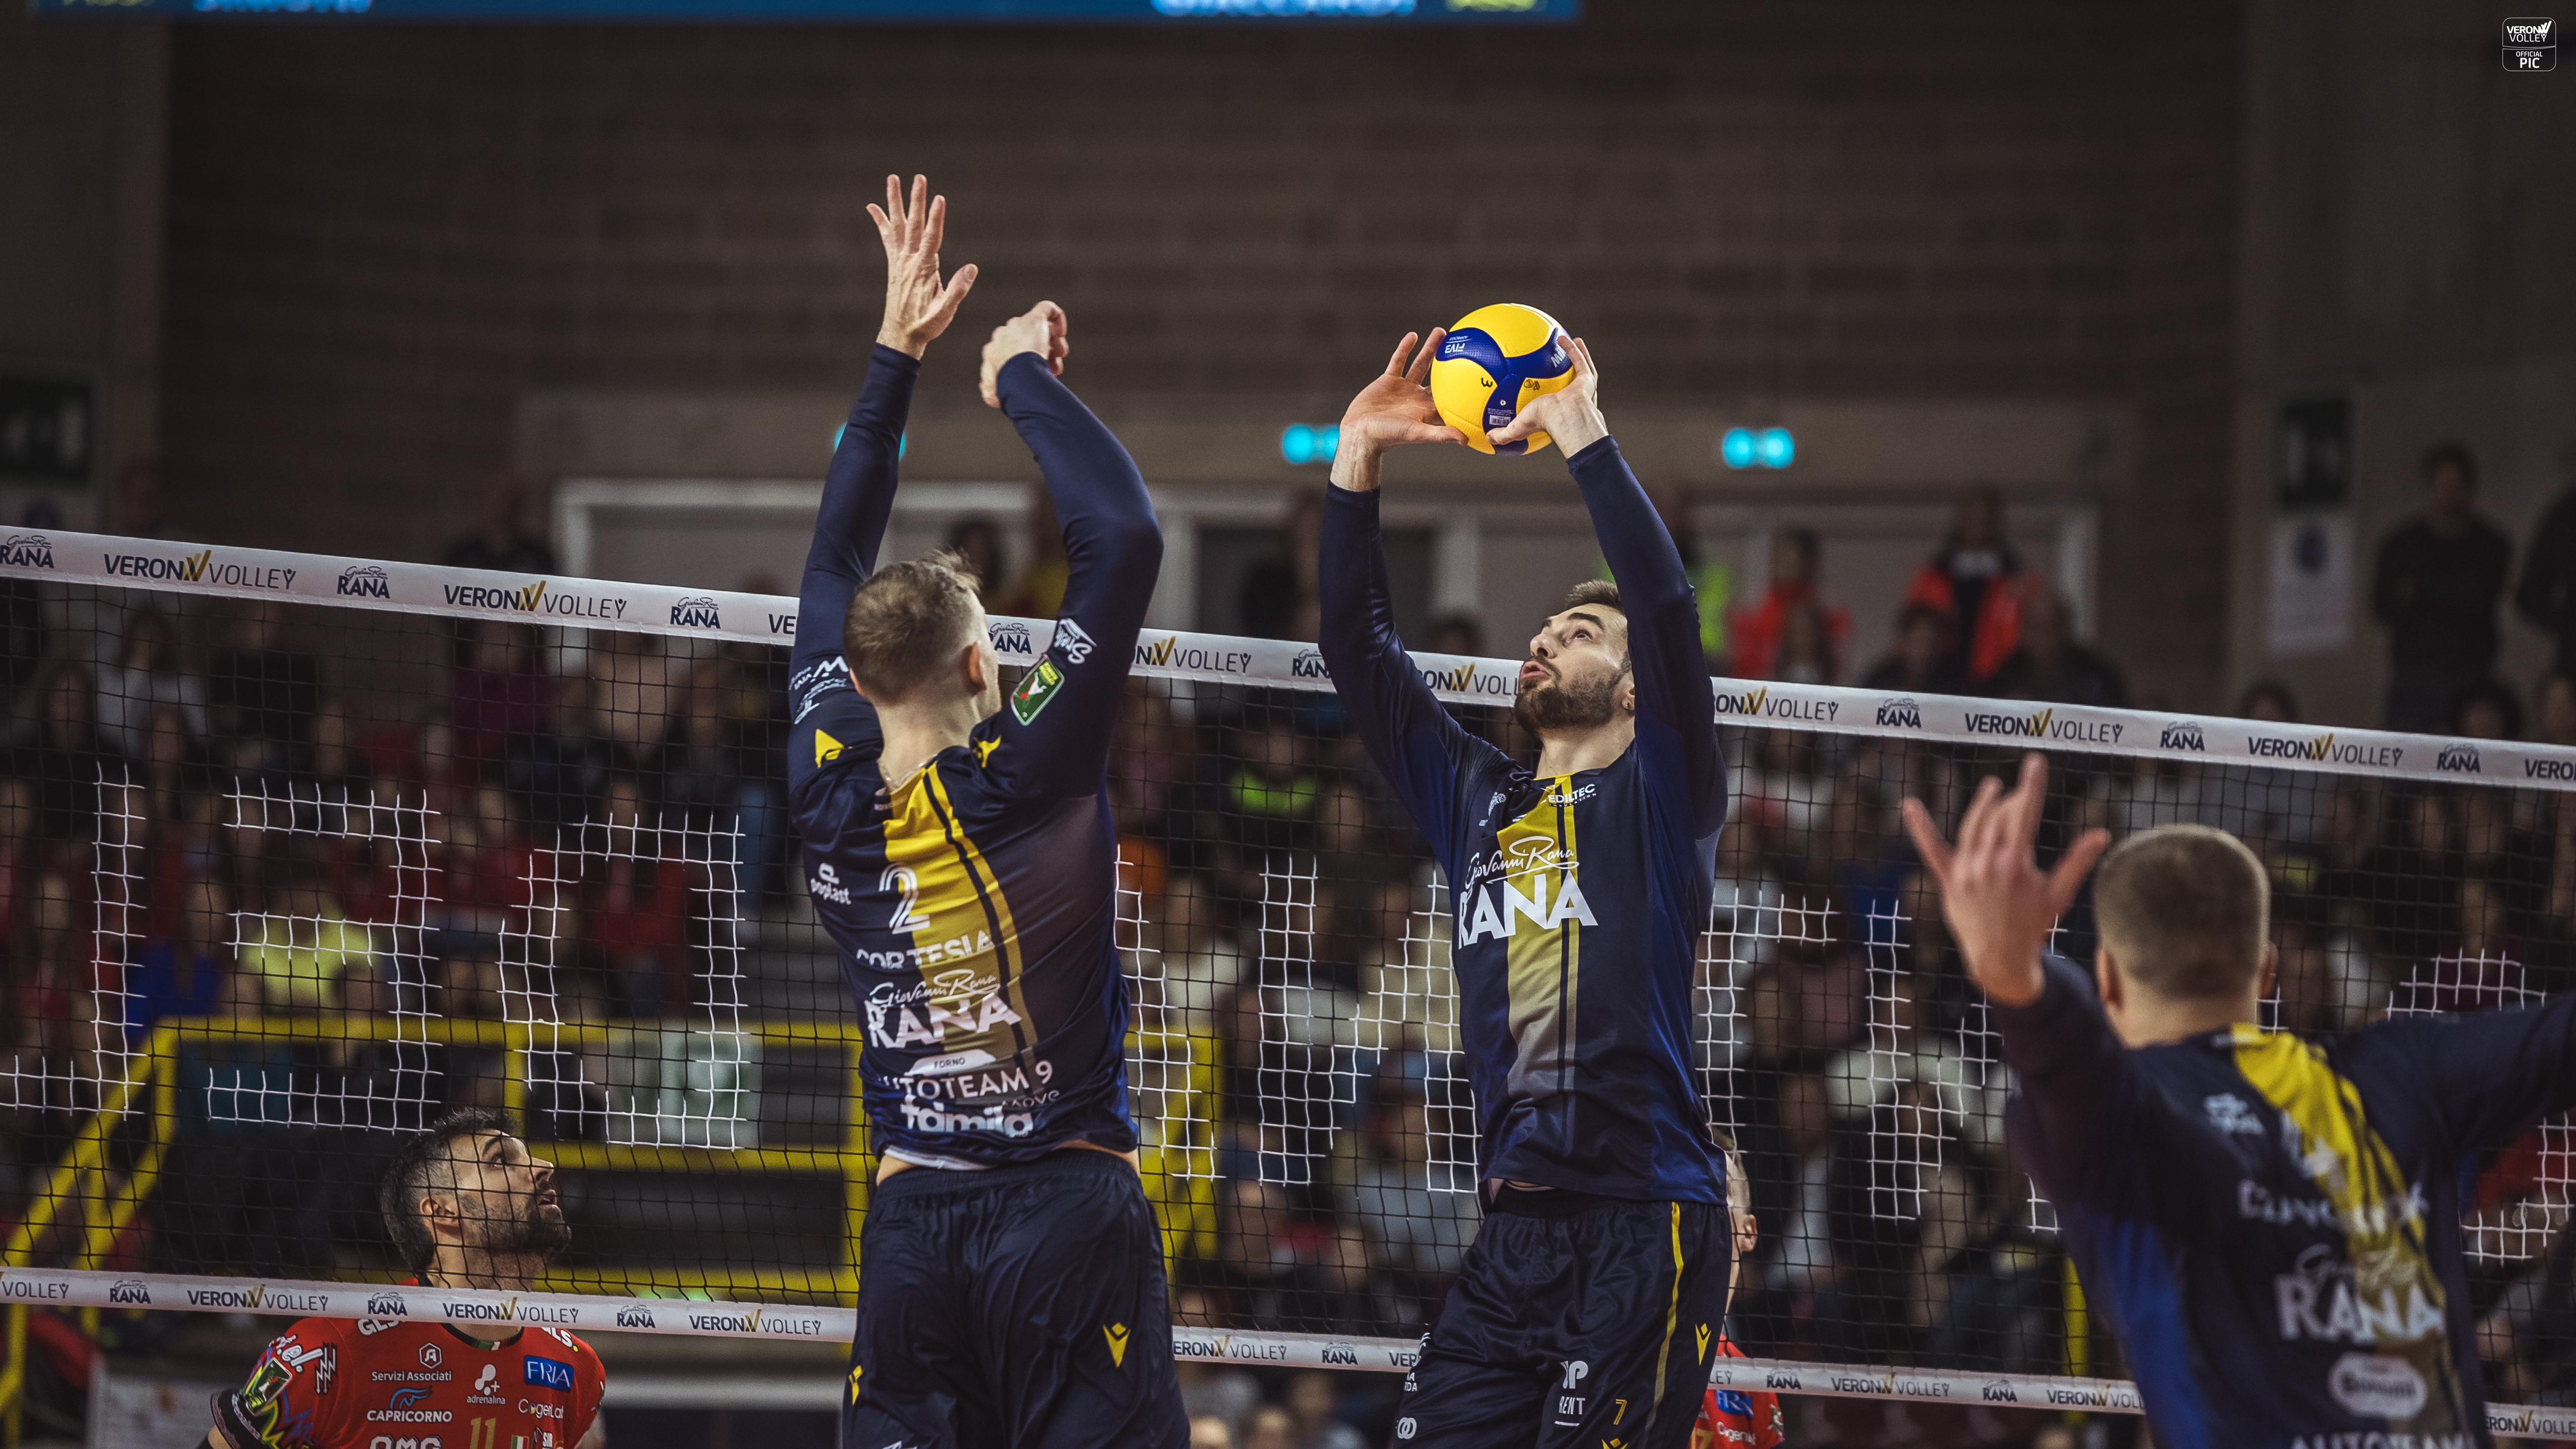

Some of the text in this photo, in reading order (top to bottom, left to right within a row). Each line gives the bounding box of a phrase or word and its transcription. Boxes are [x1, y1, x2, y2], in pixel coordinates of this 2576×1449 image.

[0, 545, 54, 569] RANA
[208, 562, 296, 590] VOLLEY
[337, 575, 390, 599] RANA
[543, 593, 627, 619] VOLLEY
[670, 606, 721, 629] RANA
[1174, 648, 1252, 673] VOLLEY
[1292, 657, 1330, 679] RAN
[1765, 697, 1839, 721] VOLLEY
[1876, 707, 1921, 729] RANA
[2051, 720, 2124, 743] VOLLEY
[2160, 730, 2205, 751] RANA
[2332, 744, 2403, 767] VOLLEY
[2437, 752, 2481, 773] RANA
[1548, 783, 1595, 803] EDILTEC
[878, 861, 931, 935] 2
[1458, 869, 1598, 949] RANA
[863, 992, 1022, 1049] RANA
[1035, 1059, 1054, 1085] 9
[2, 1281, 69, 1299] VOLLEY
[109, 1287, 151, 1304] RANA
[264, 1294, 329, 1312] VOLLEY
[367, 1299, 408, 1316] RANA
[516, 1307, 579, 1323] VOLLEY
[616, 1312, 656, 1329] RANA
[761, 1318, 822, 1335] VOLLEY
[1230, 1344, 1287, 1360] VOLLEY
[1322, 1349, 1358, 1365] RANA
[372, 1371, 452, 1381] Servizi Associati
[527, 1360, 571, 1388] FRIA
[1766, 1375, 1802, 1391] RANA
[1895, 1381, 1950, 1397] VOLLEY
[1983, 1387, 2018, 1403] RANA
[466, 1395, 506, 1405] adrenalina
[1558, 1396, 1586, 1415] RENT
[367, 1410, 453, 1422] CAPRICORNO
[1613, 1399, 1628, 1425] 7
[470, 1417, 496, 1449] 11
[2532, 1417, 2576, 1434] VOLLE
